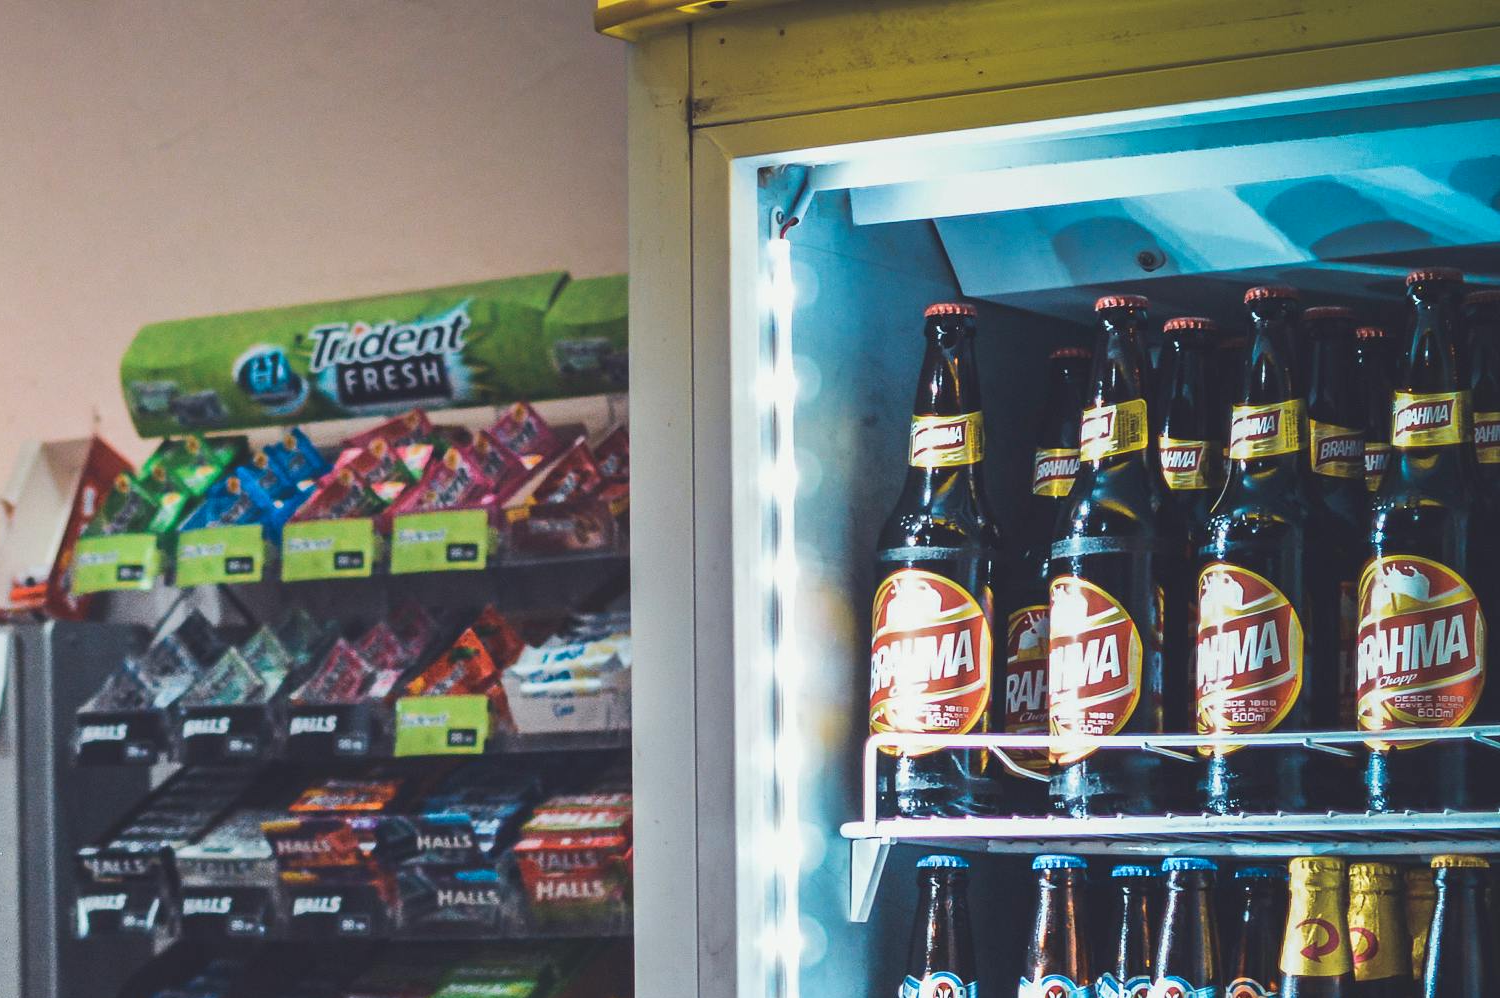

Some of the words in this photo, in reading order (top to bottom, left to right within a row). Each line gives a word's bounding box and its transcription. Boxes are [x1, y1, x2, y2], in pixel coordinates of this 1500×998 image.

[311, 311, 468, 371] Trident
[344, 361, 440, 394] FRESH
[1379, 673, 1418, 687] Chopp
[1231, 712, 1266, 722] 600ml
[1417, 708, 1454, 719] 600ml
[417, 834, 473, 850] HALLS
[438, 889, 500, 907] HALLS
[536, 880, 606, 901] HALLS
